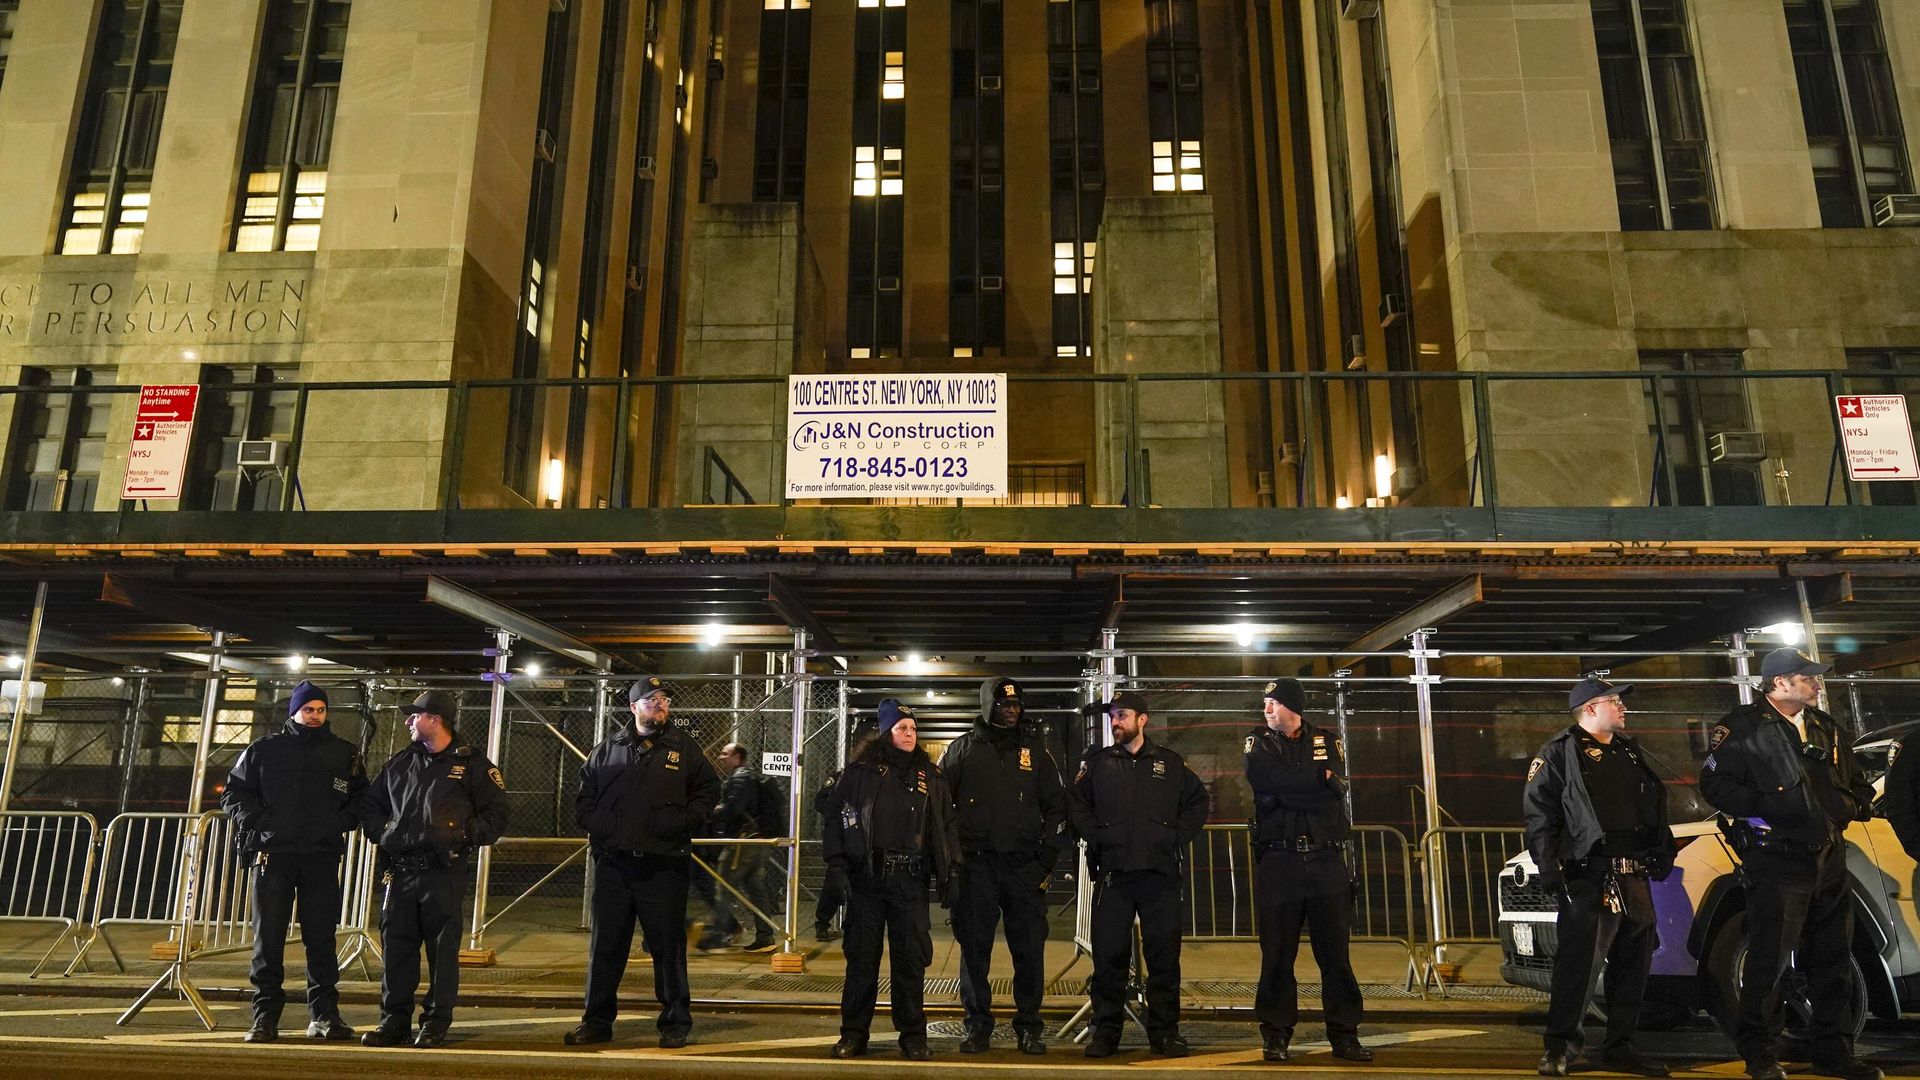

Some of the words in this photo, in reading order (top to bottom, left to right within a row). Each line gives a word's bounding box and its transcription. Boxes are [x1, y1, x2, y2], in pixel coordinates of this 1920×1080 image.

[68, 282, 113, 305] TO
[134, 281, 198, 304] ALL
[225, 279, 305, 303] MEN
[45, 308, 301, 335] PERSUASION
[143, 388, 155, 397] NO
[155, 388, 190, 397] STANDING
[793, 380, 812, 406] 100
[814, 380, 859, 406] CENTRE
[862, 379, 878, 405] ST.
[881, 379, 907, 405] NEW
[909, 379, 945, 409] YORK,
[947, 379, 963, 405] NY
[966, 379, 997, 404] 10013
[142, 397, 172, 406] Anytime
[820, 422, 861, 439] J&N
[868, 421, 994, 439] Construction
[1846, 428, 1868, 437] NYSJ
[821, 441, 901, 450] GROUP
[132, 450, 152, 458] NYSJ
[819, 456, 968, 478] 718-845-0123
[790, 483, 803, 492] For
[804, 484, 823, 492] more
[824, 482, 867, 492] information,
[869, 482, 893, 493] please
[894, 482, 910, 491] visit
[911, 482, 996, 494] www.nyc.gov/buildings.
[673, 718, 690, 727] 100
[773, 755, 789, 763] 100
[763, 763, 792, 771] CENTR
